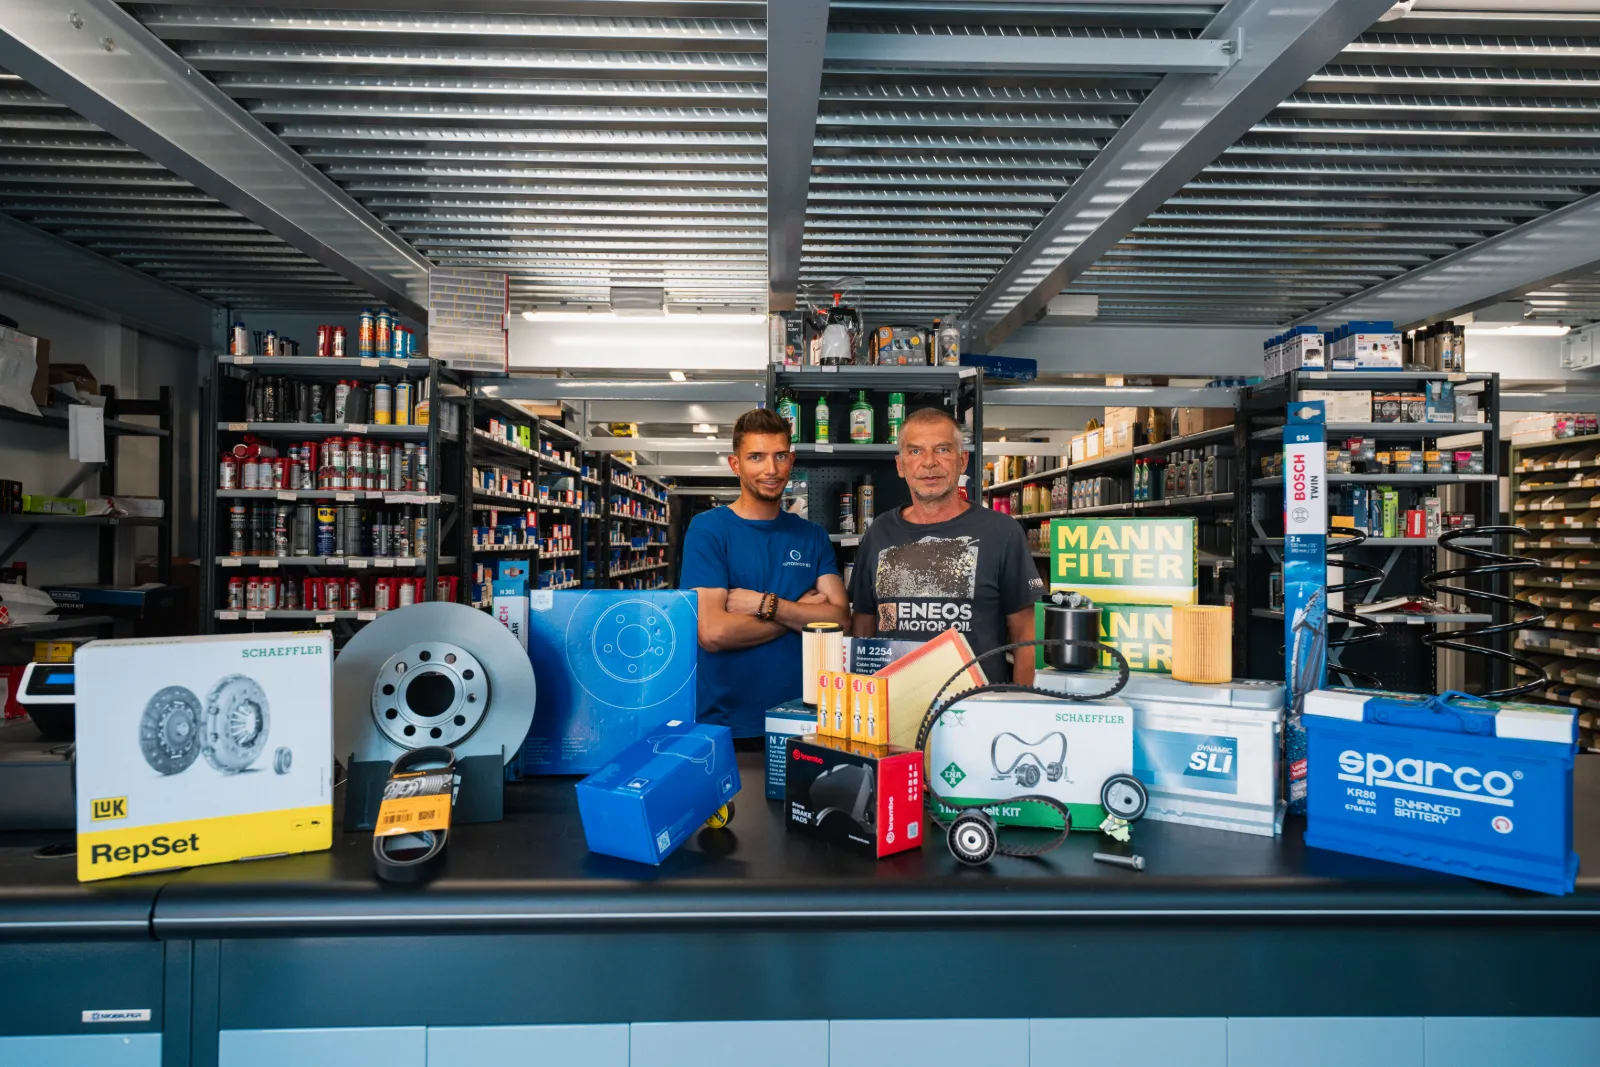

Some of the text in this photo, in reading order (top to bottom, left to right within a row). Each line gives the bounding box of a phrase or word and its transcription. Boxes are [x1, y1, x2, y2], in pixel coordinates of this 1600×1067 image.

[1293, 454, 1306, 501] BOSCH
[1311, 475, 1319, 500] TWIN
[1057, 525, 1184, 550] MANN
[1058, 553, 1185, 579] FILTER
[898, 602, 972, 620] ENEOS
[898, 620, 972, 632] MOTOR OIL
[1099, 612, 1173, 640] NN
[242, 645, 323, 658] SCHAEFFLER
[856, 646, 893, 656] M 2254
[1056, 713, 1125, 724] SCHAEFFLER
[769, 735, 777, 744] N
[1196, 744, 1233, 755] DYNAMIC
[801, 753, 824, 765] brembo
[1188, 752, 1233, 774] SLI
[1338, 750, 1514, 797] sparco
[1346, 787, 1377, 800] KR80
[792, 807, 812, 820] BRAKE
[887, 796, 895, 832] brembo
[1002, 806, 1022, 817] KIT
[1365, 807, 1377, 815] EN
[1394, 797, 1461, 817] ENHANCED
[792, 814, 808, 825] PADS
[1394, 807, 1449, 825] BATTERY
[91, 833, 200, 865] RepSet
